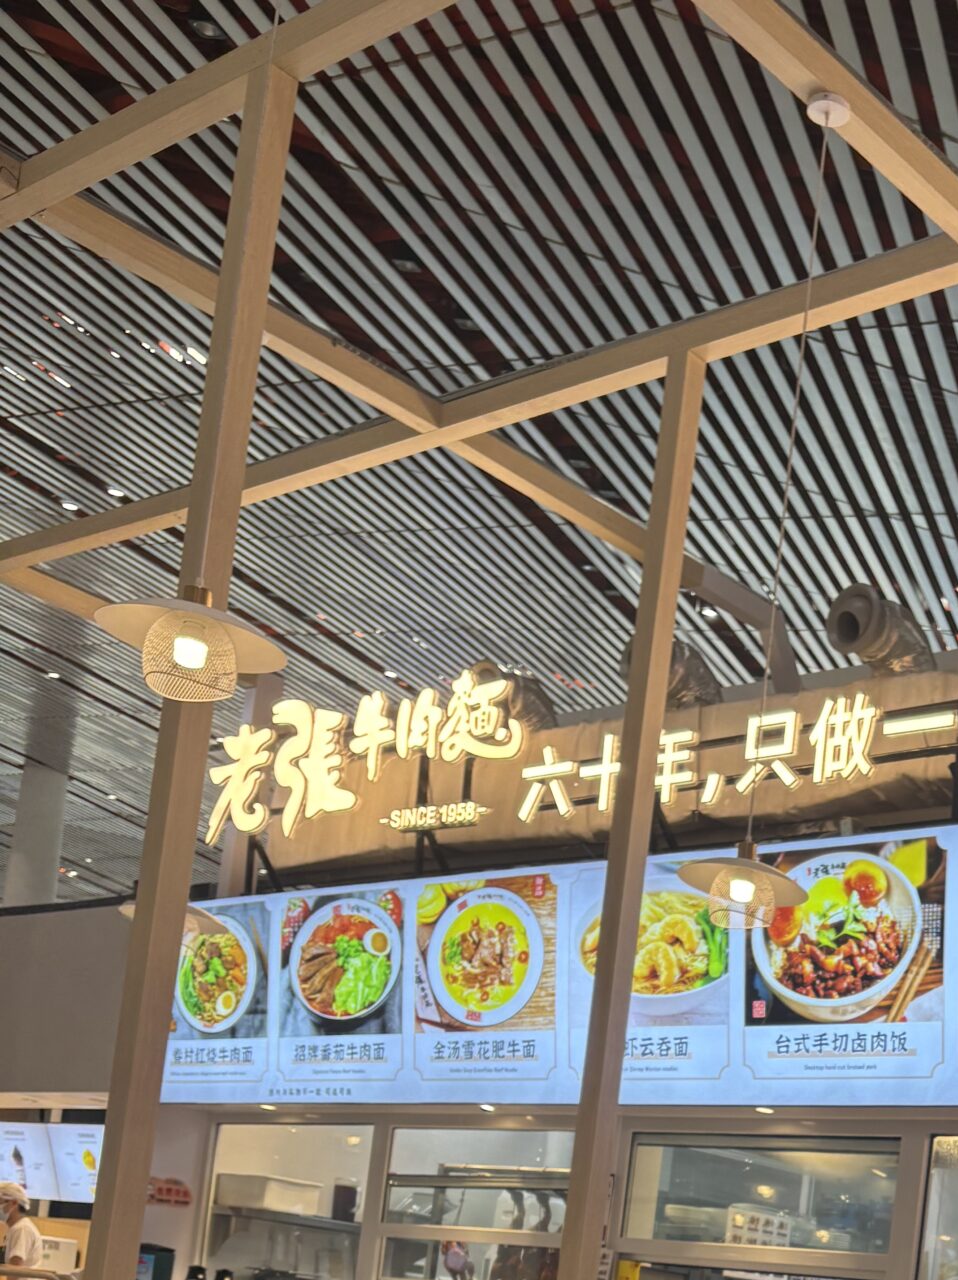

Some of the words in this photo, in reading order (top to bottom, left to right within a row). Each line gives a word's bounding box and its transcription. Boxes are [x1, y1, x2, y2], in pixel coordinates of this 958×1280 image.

[294, 1042, 385, 1062] 招牌番茄牛肉面
[433, 1039, 536, 1060] 金汤雪花肥牛面
[775, 1031, 908, 1055] 台式手切卤肉饭
